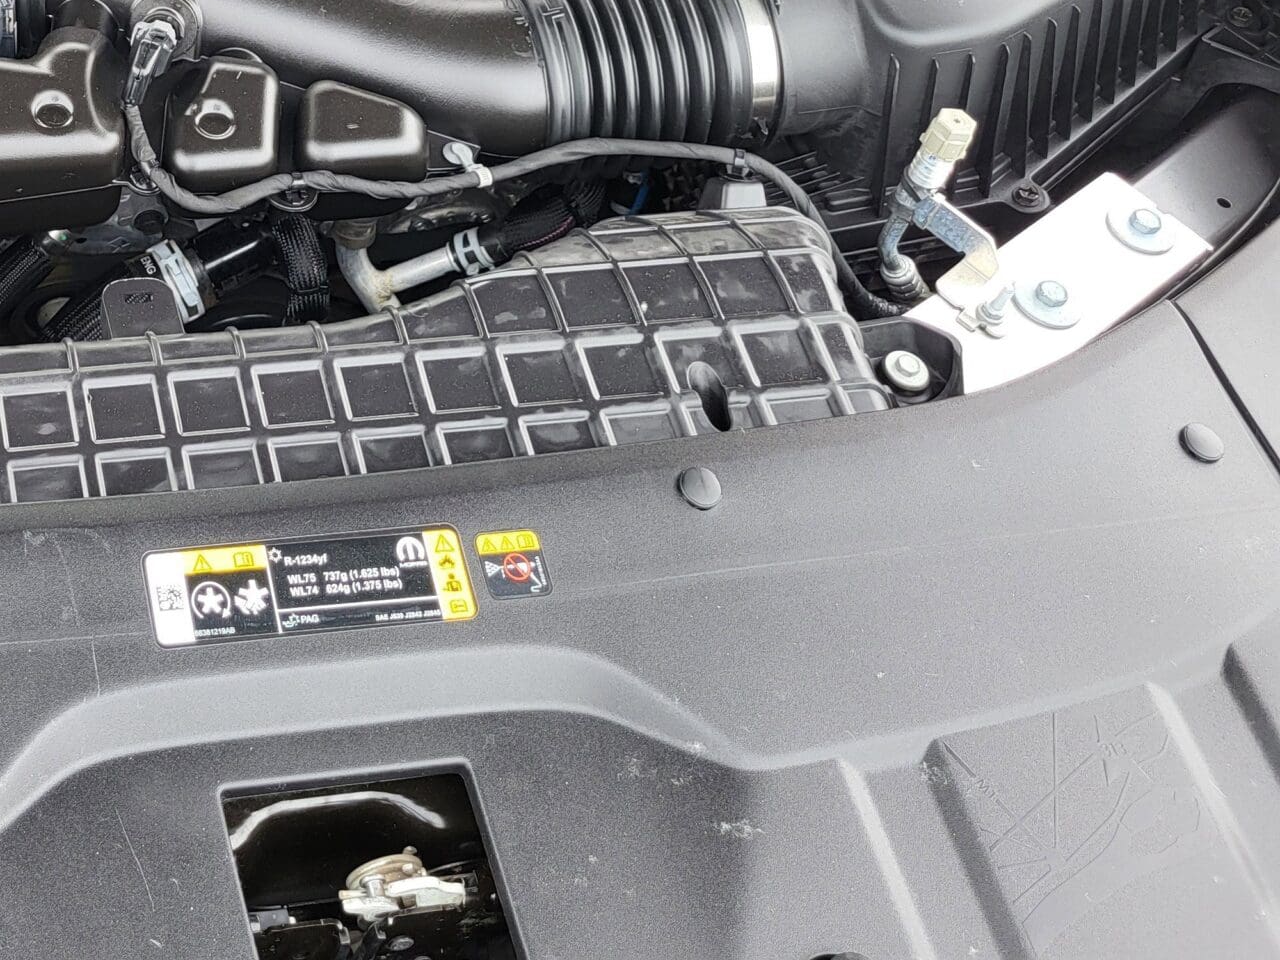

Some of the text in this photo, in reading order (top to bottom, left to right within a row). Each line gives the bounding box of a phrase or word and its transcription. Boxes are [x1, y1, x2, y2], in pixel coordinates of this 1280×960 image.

[140, 255, 157, 275] ENG
[283, 553, 327, 566] R-1234yf
[287, 565, 400, 584] WL75 737g (1.625 lbs)
[289, 578, 403, 597] WL74 624g (1.375 lbs)
[300, 613, 319, 624] PAG
